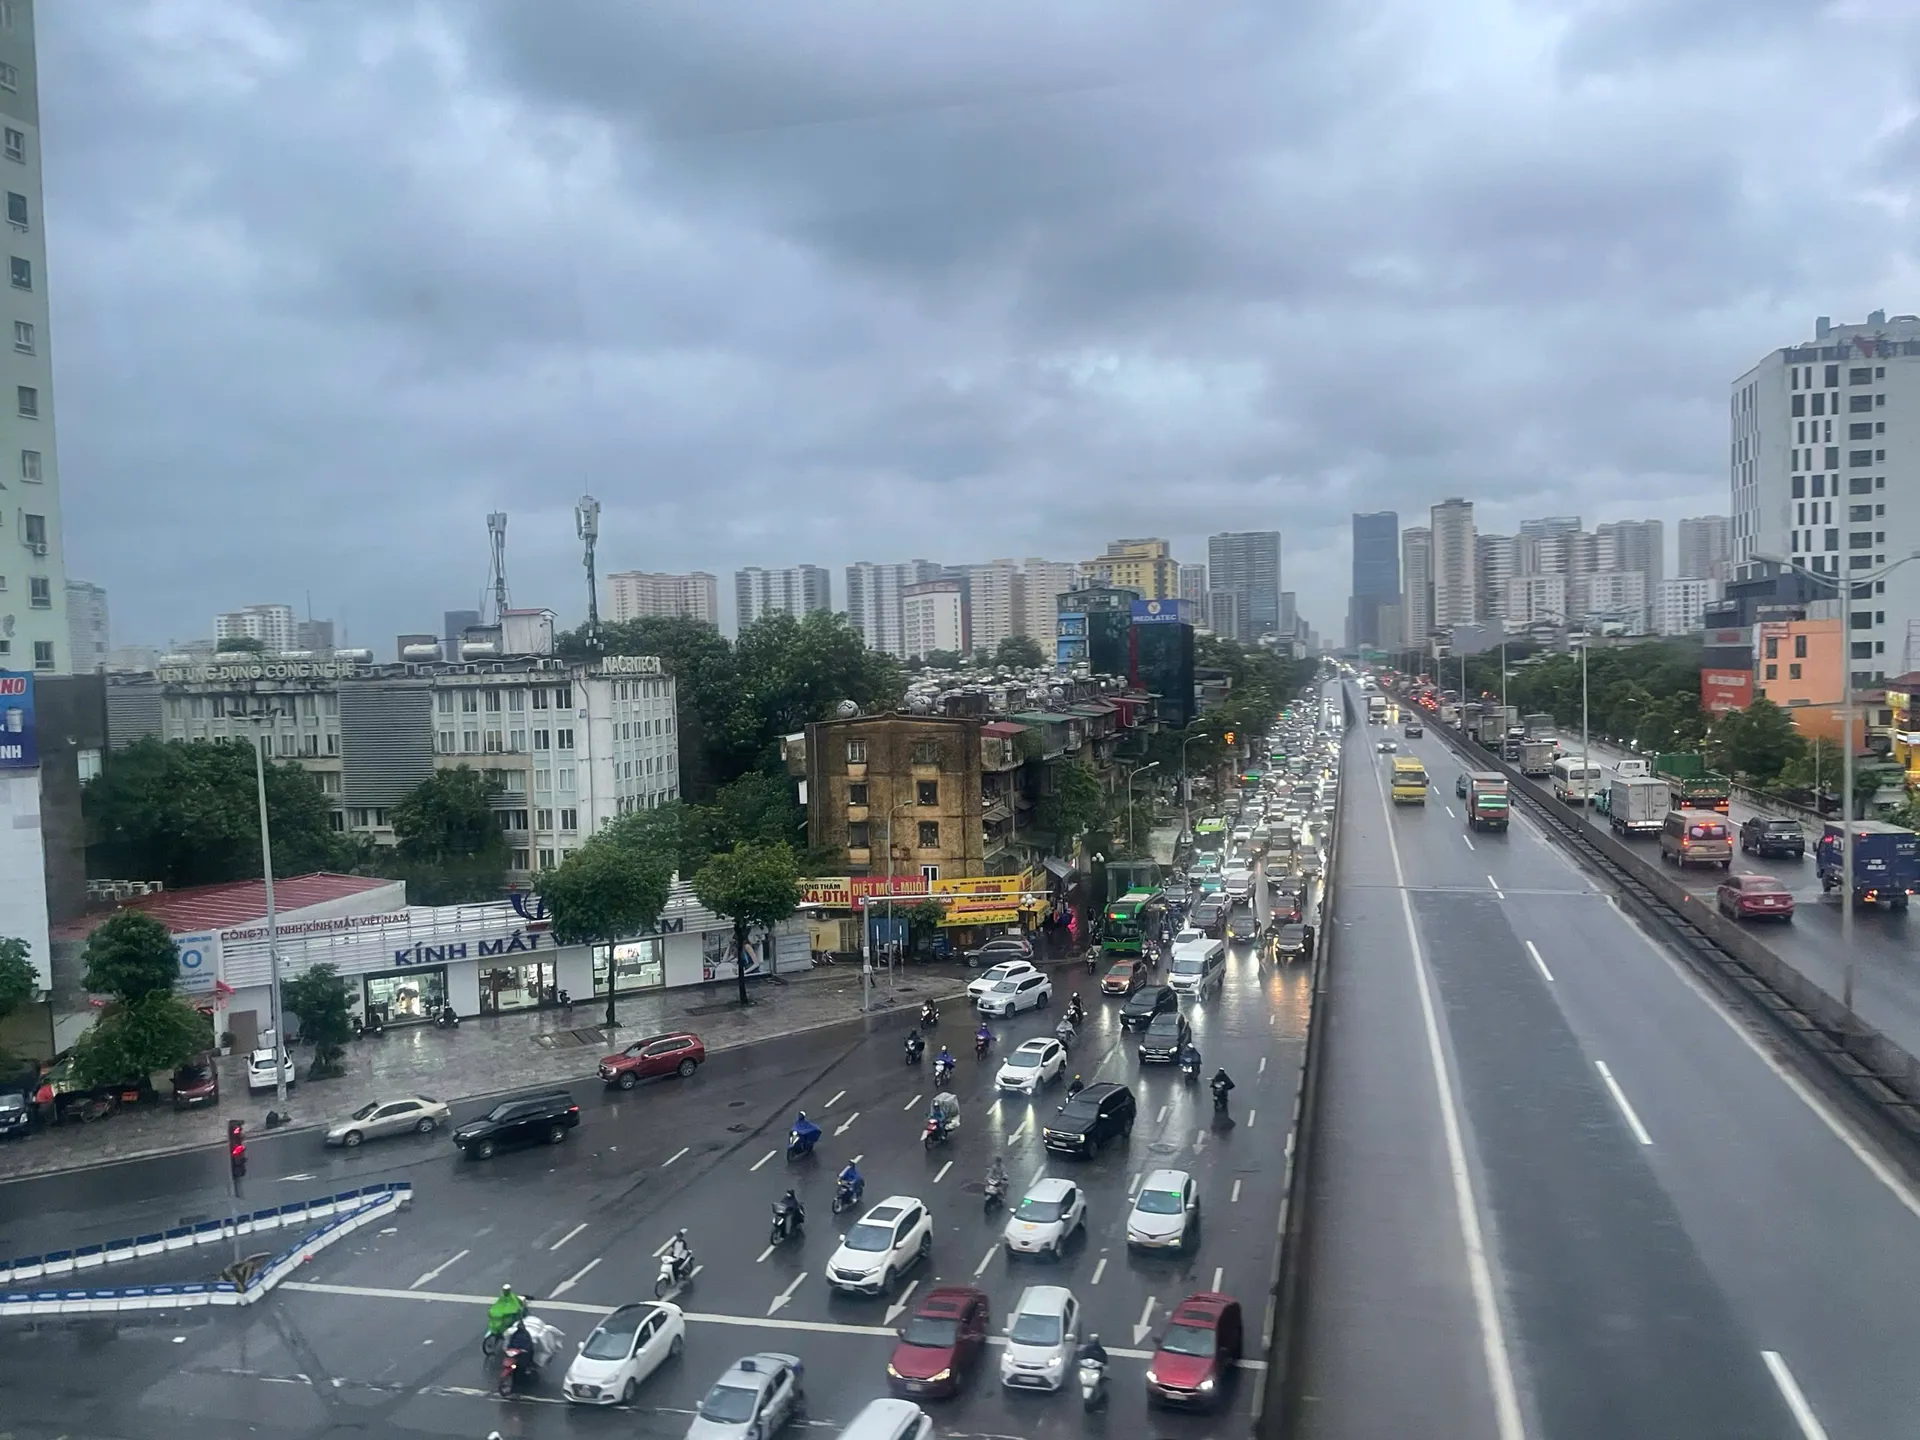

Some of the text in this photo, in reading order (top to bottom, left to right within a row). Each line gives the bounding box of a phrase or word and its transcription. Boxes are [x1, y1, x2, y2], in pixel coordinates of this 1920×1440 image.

[602, 655, 661, 674] NACENTECH
[852, 881, 874, 897] DIỆT
[395, 941, 467, 966] KÍNH
[478, 929, 541, 957] MẮT
